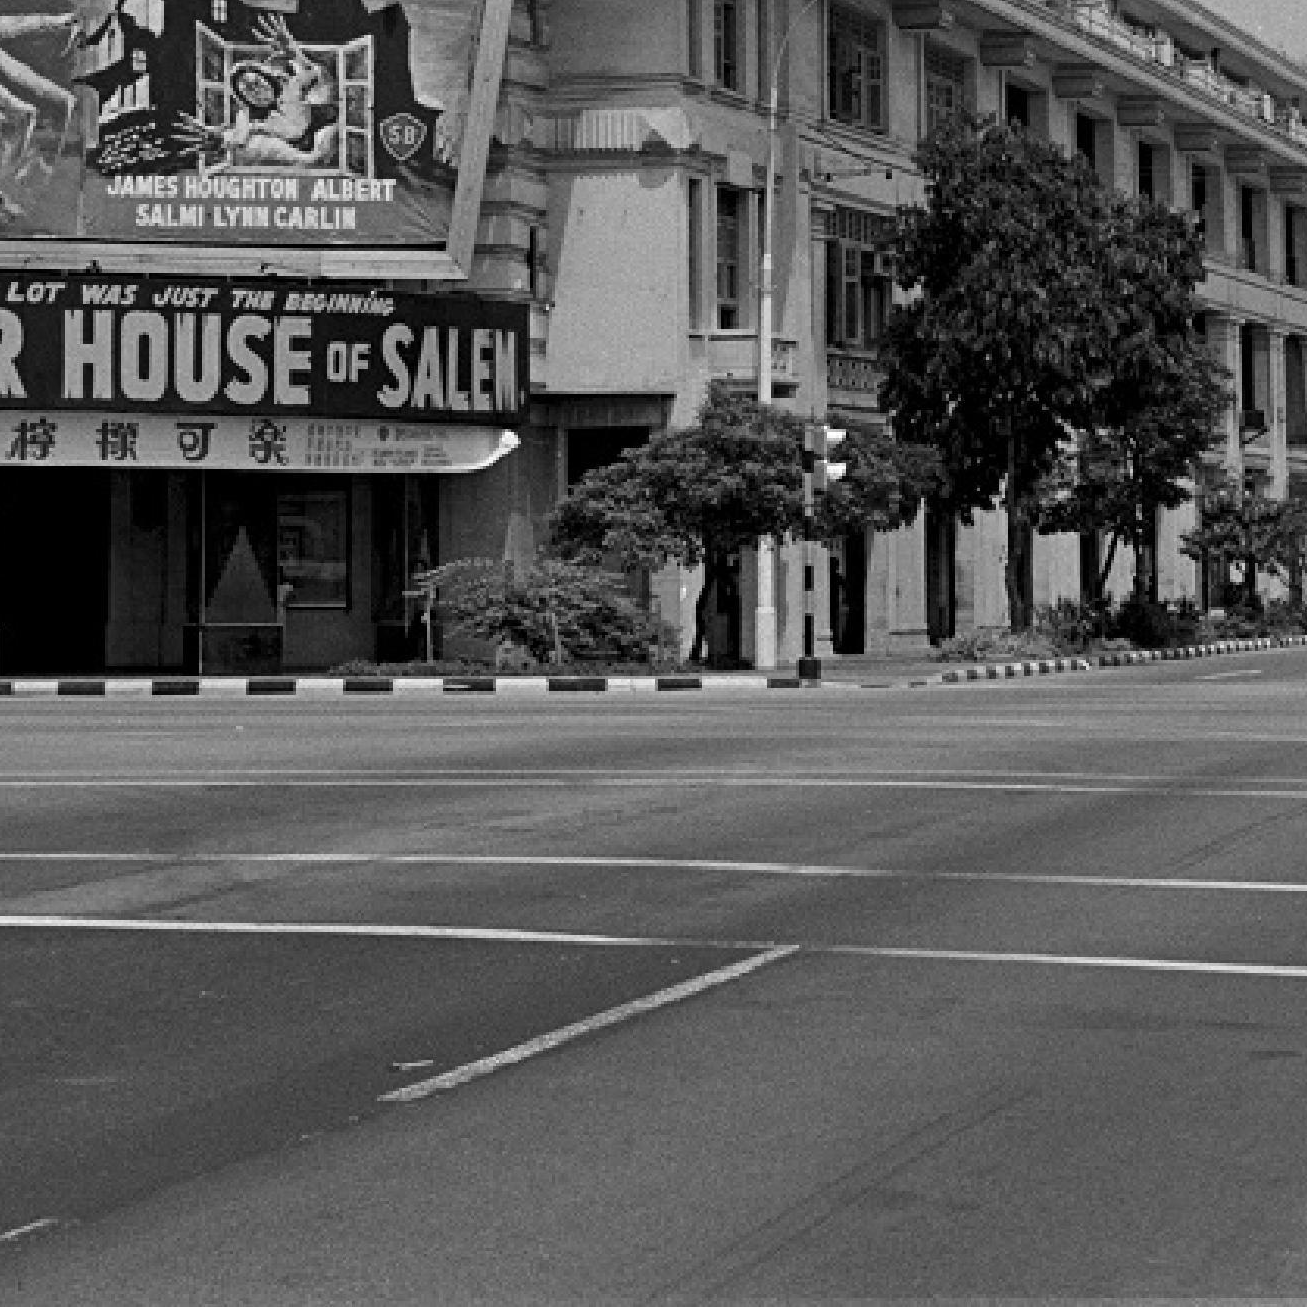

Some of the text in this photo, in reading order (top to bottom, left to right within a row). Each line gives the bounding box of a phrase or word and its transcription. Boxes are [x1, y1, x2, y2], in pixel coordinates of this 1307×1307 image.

[108, 175, 396, 202] JAMES HOUGHTON ALBERT
[135, 205, 357, 231] SALMI LYNN CARLIN
[4, 281, 67, 303] LOT
[81, 284, 139, 306] WAS
[152, 287, 219, 308] JUST
[232, 290, 275, 311] THE
[63, 308, 313, 406] HOUSE
[326, 340, 373, 384] OF
[377, 322, 526, 412] SALEM
